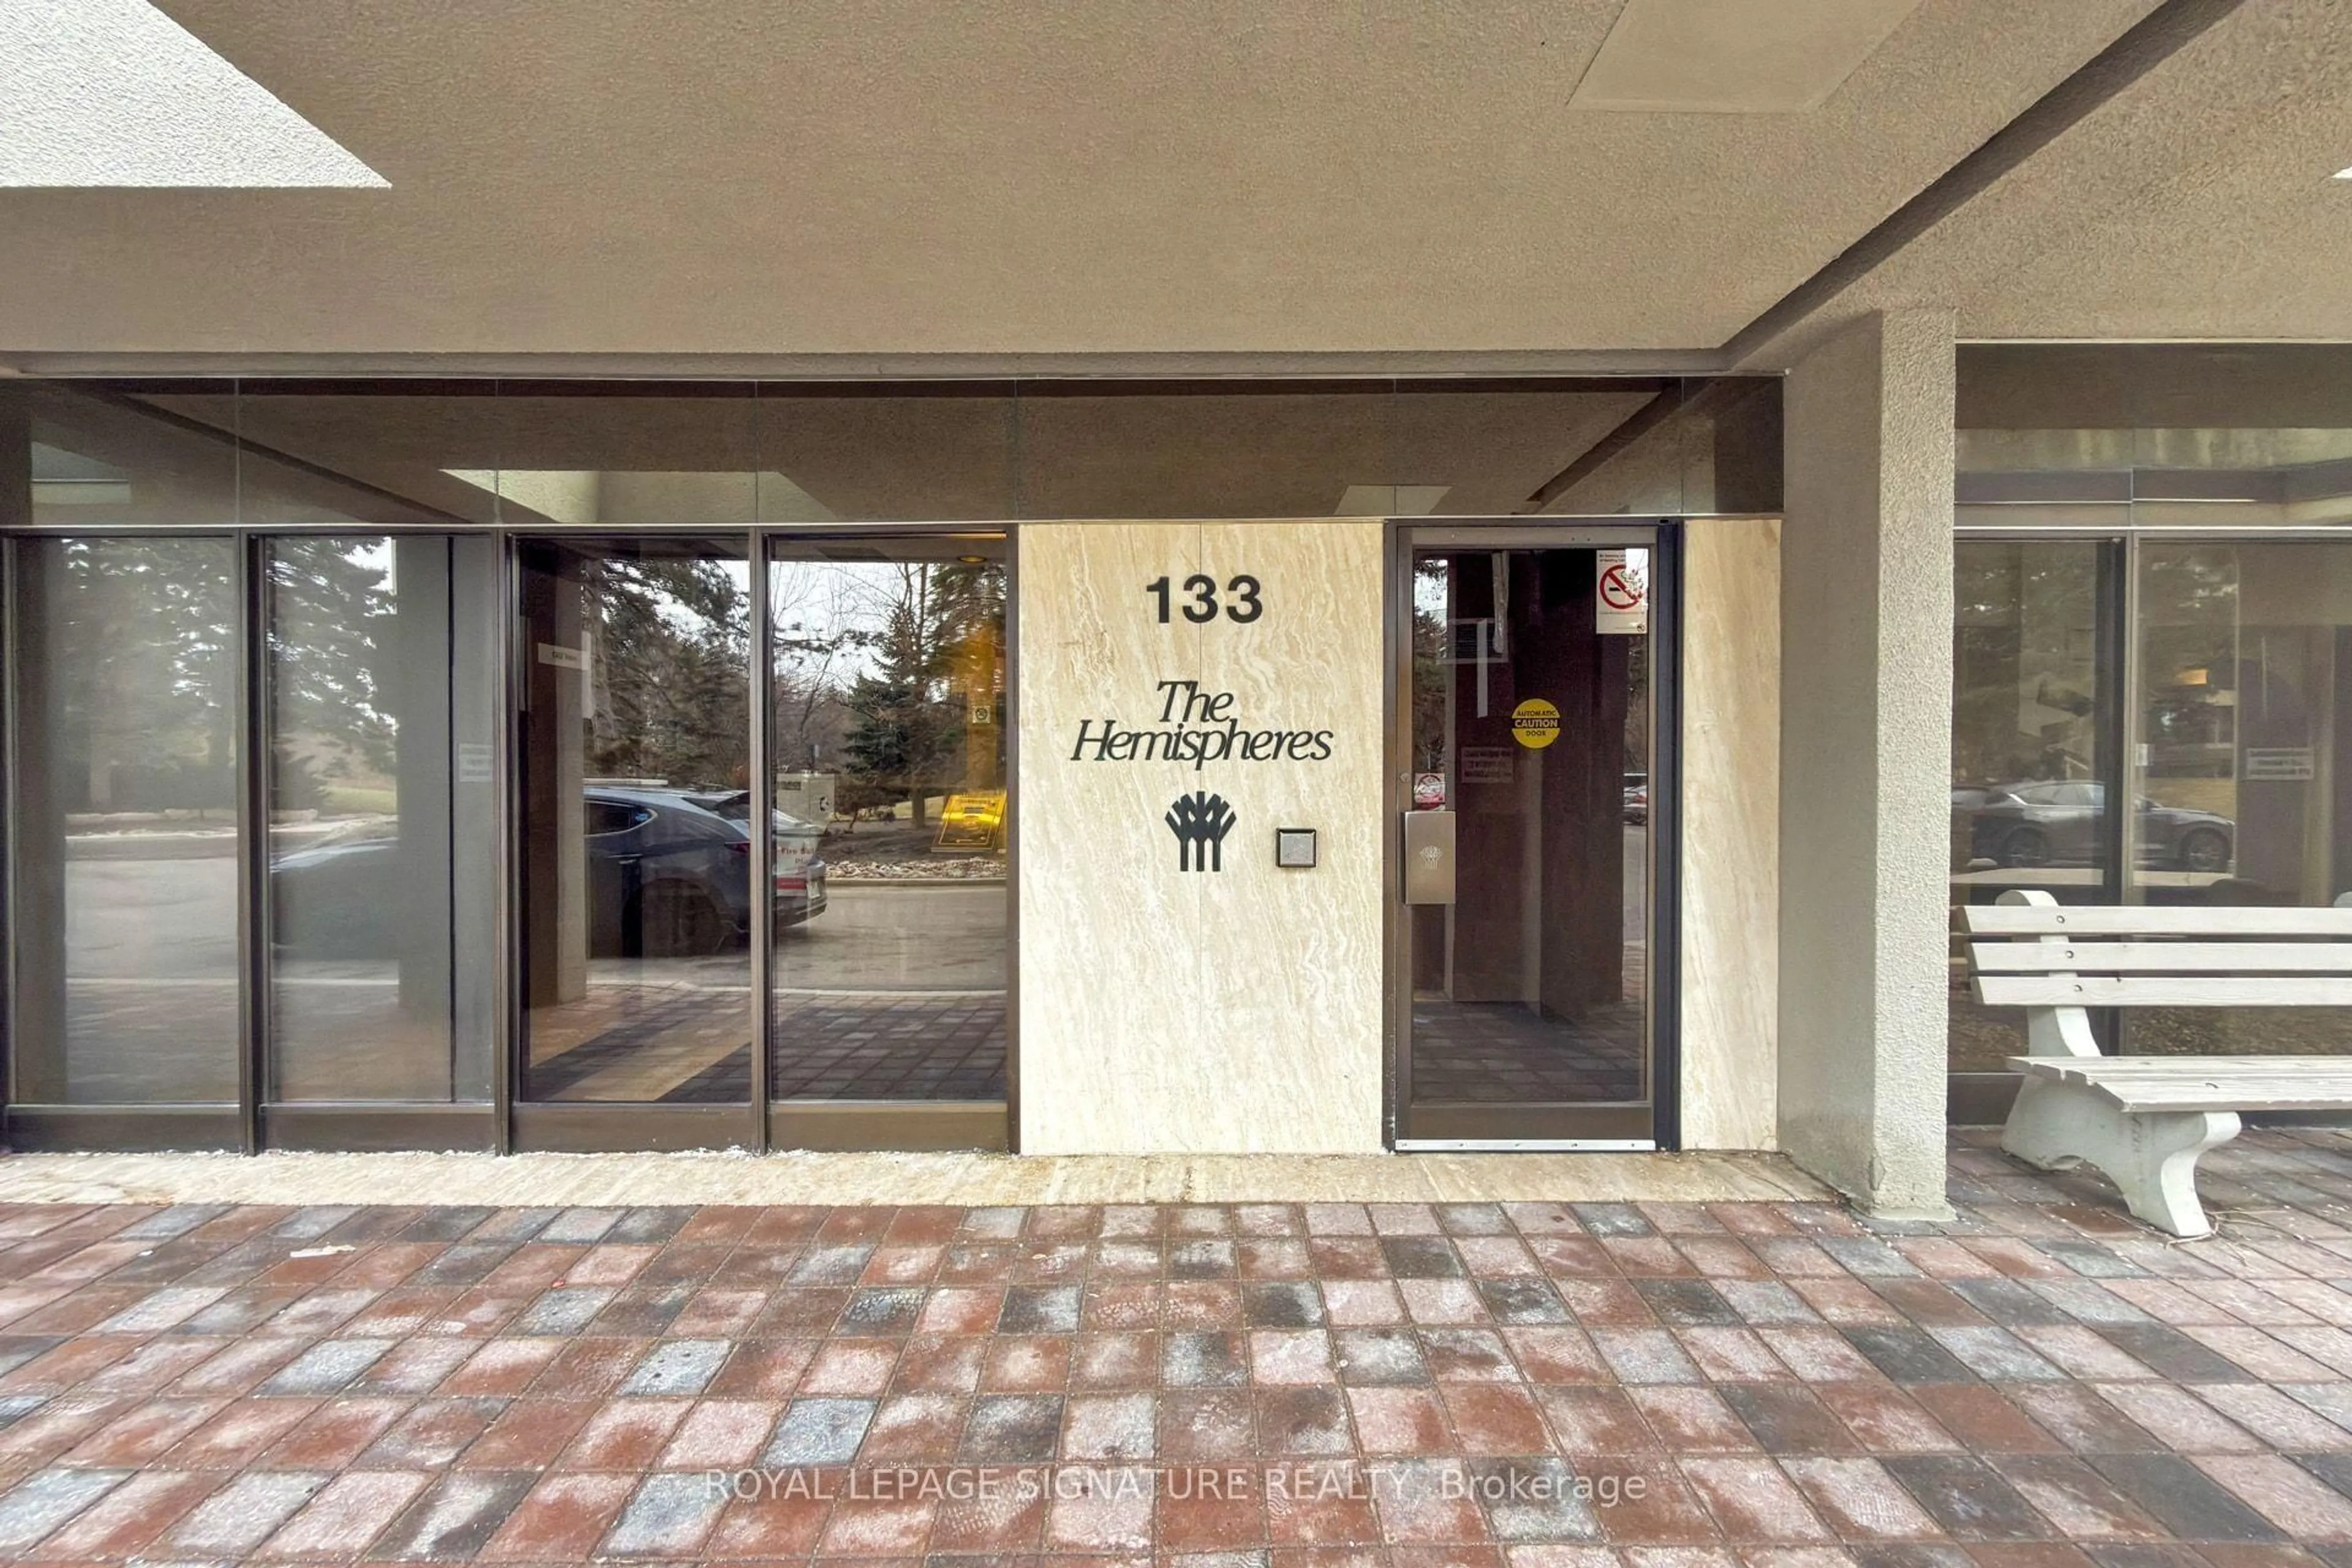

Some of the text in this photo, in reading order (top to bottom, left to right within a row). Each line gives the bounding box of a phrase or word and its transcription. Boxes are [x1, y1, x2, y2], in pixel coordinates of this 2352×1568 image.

[1147, 574, 1263, 624] 133
[1157, 680, 1234, 722] The
[1515, 718, 1558, 728] CAUTION
[1071, 718, 1334, 771] Hemispheres
